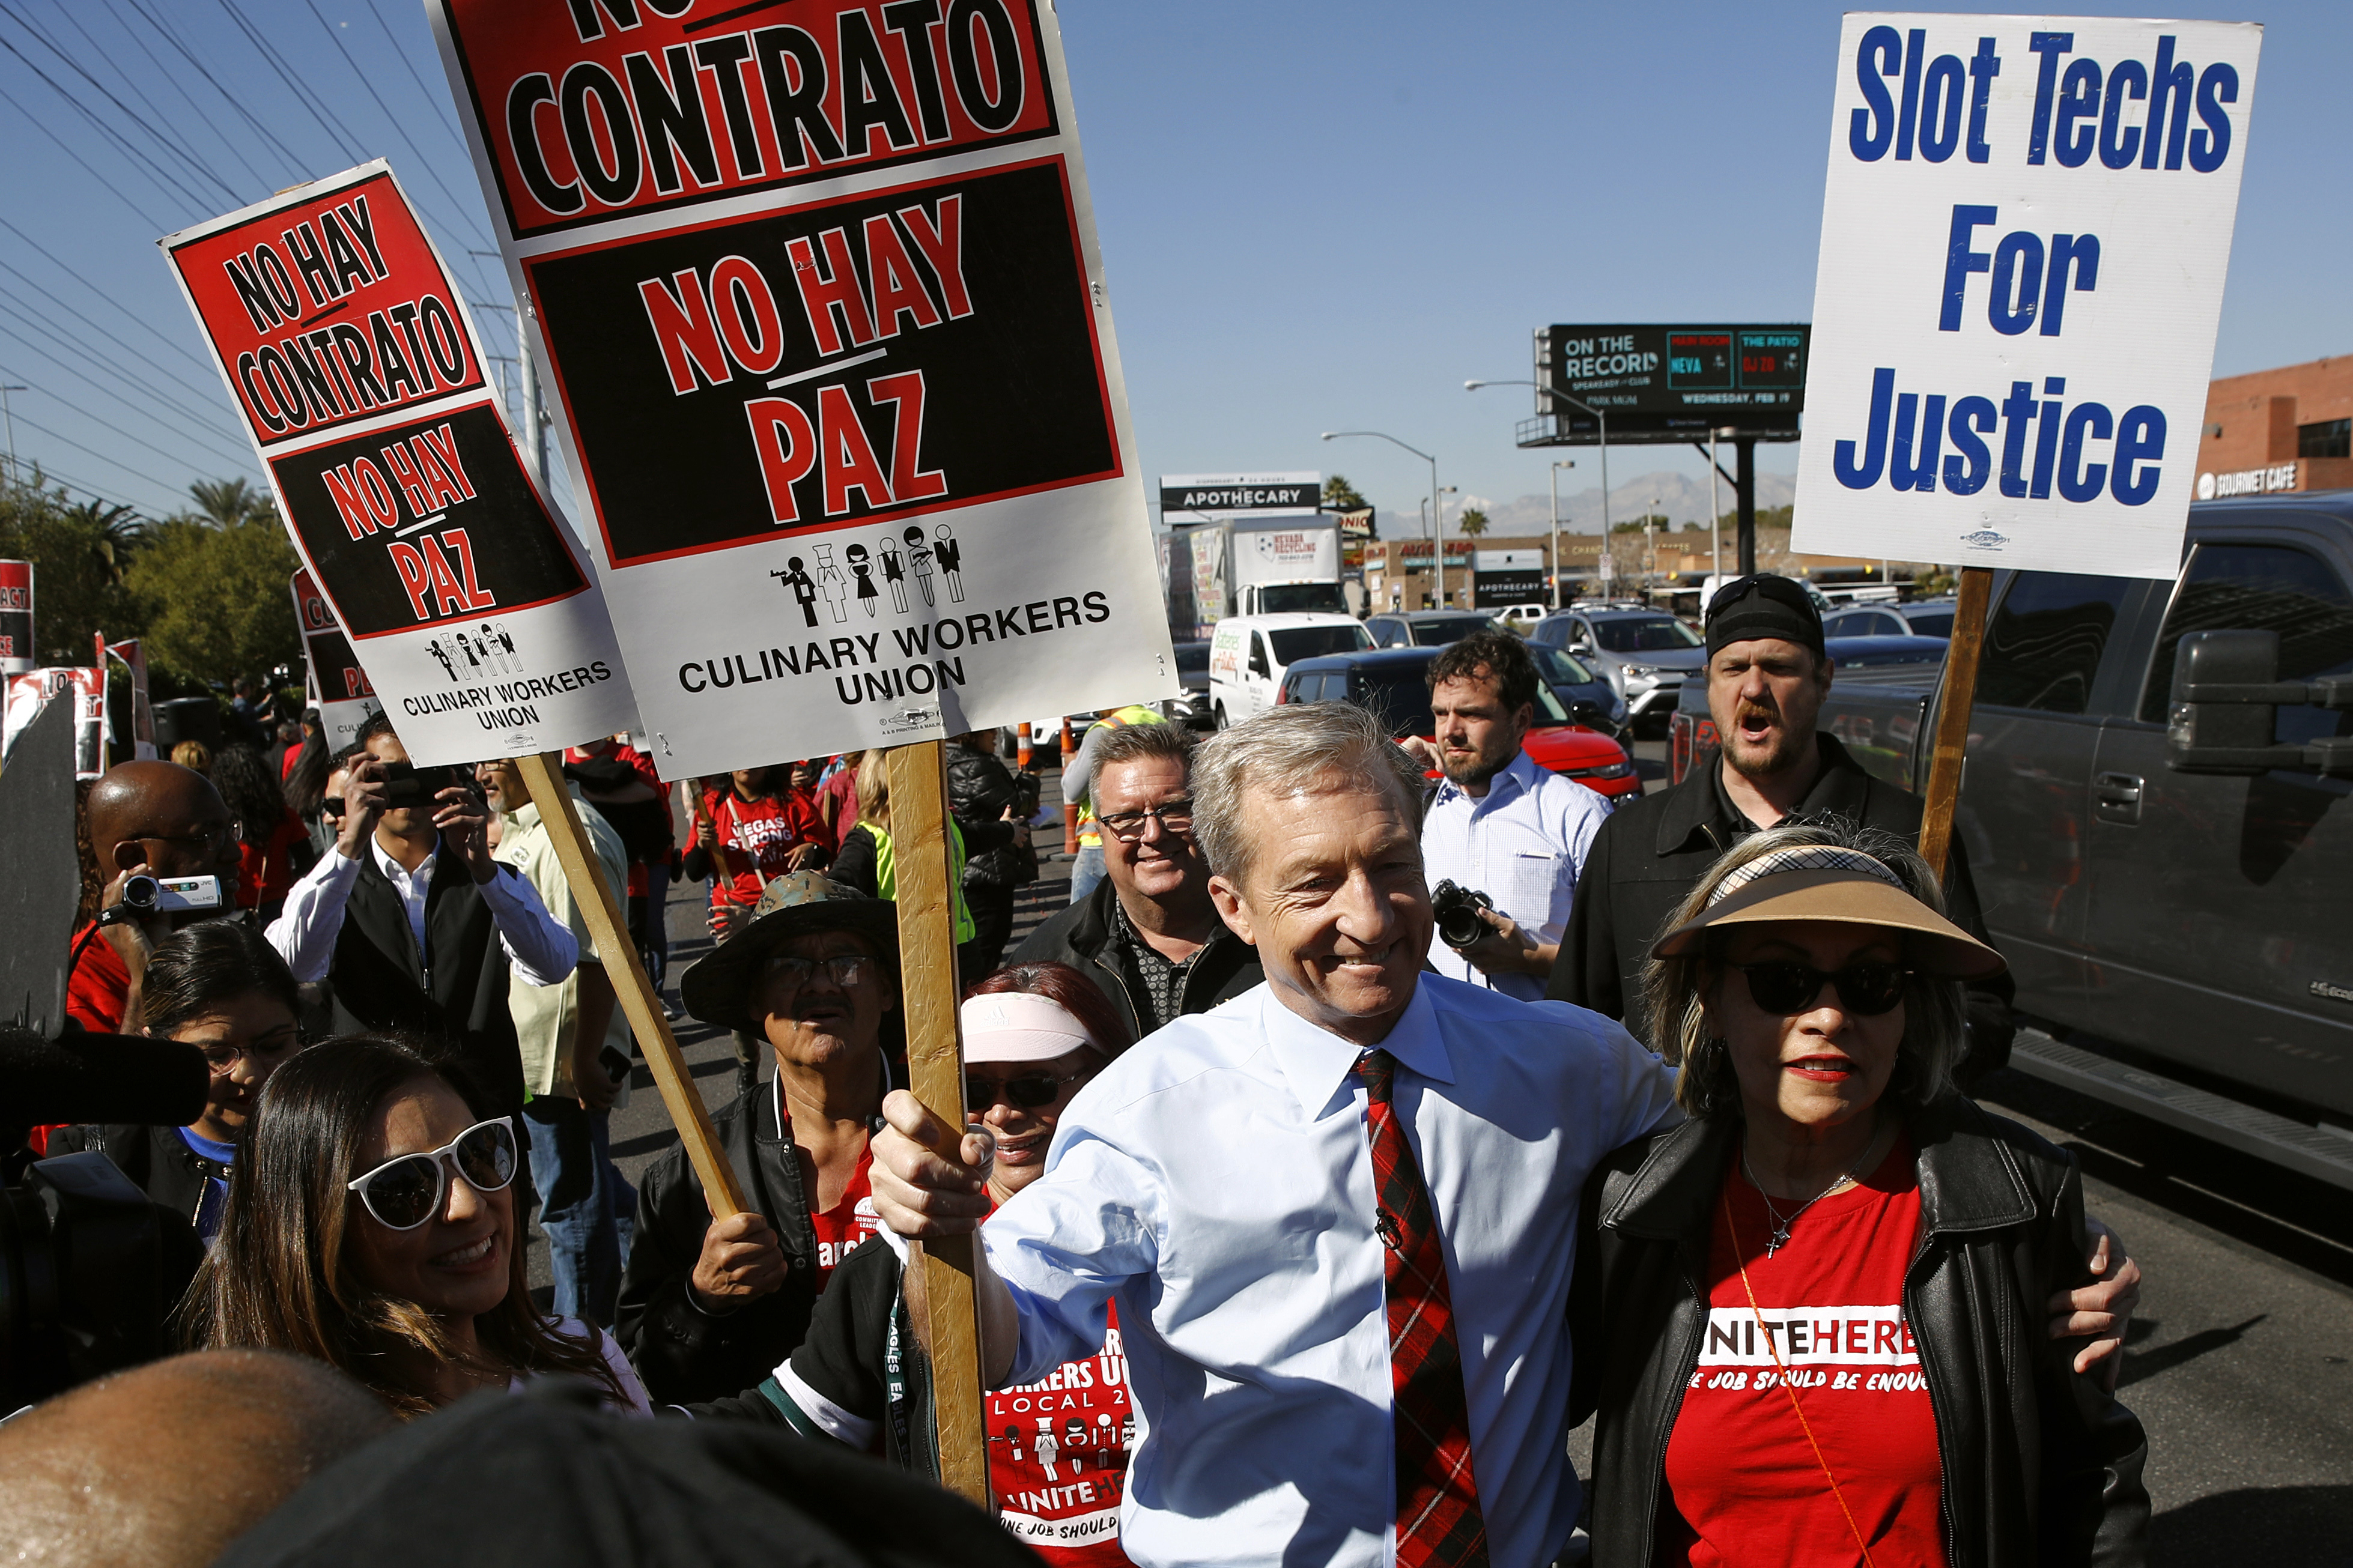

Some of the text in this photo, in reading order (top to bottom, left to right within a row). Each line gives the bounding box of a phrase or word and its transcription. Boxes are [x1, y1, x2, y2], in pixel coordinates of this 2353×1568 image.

[506, 0, 1025, 215] CONTRATO
[1849, 25, 2239, 174] Slot Techs
[222, 194, 390, 335] NO HAY
[1938, 204, 2100, 336] For
[637, 193, 974, 396] NO HAY
[237, 294, 466, 434] CONTRATO
[1565, 334, 1635, 357] ON THE
[1566, 351, 1659, 379] RECORD
[1743, 336, 1800, 347] THE PATIO
[1755, 392, 1776, 404] FEB
[744, 369, 949, 525] PAZ
[1833, 367, 2167, 506] Justice
[321, 423, 477, 541] NO HAY
[1183, 489, 1301, 506] APOTHECARY
[387, 527, 496, 620] PAZ
[1478, 582, 1540, 592] APOTHECARY
[679, 591, 1110, 693] CULINARY WORKERS
[403, 660, 612, 716] CULINARY WORKERS
[836, 656, 967, 705] UNION
[476, 704, 540, 730] UNION
[980, 1017, 1010, 1027] adidas
[995, 1393, 1094, 1415] LOCAL
[1708, 1372, 1747, 1390] JOB
[1753, 1370, 1826, 1391] SHOULD
[1831, 1371, 1858, 1390] BE
[1027, 1522, 1054, 1536] JOB
[1060, 1516, 1117, 1539] SHOULD
